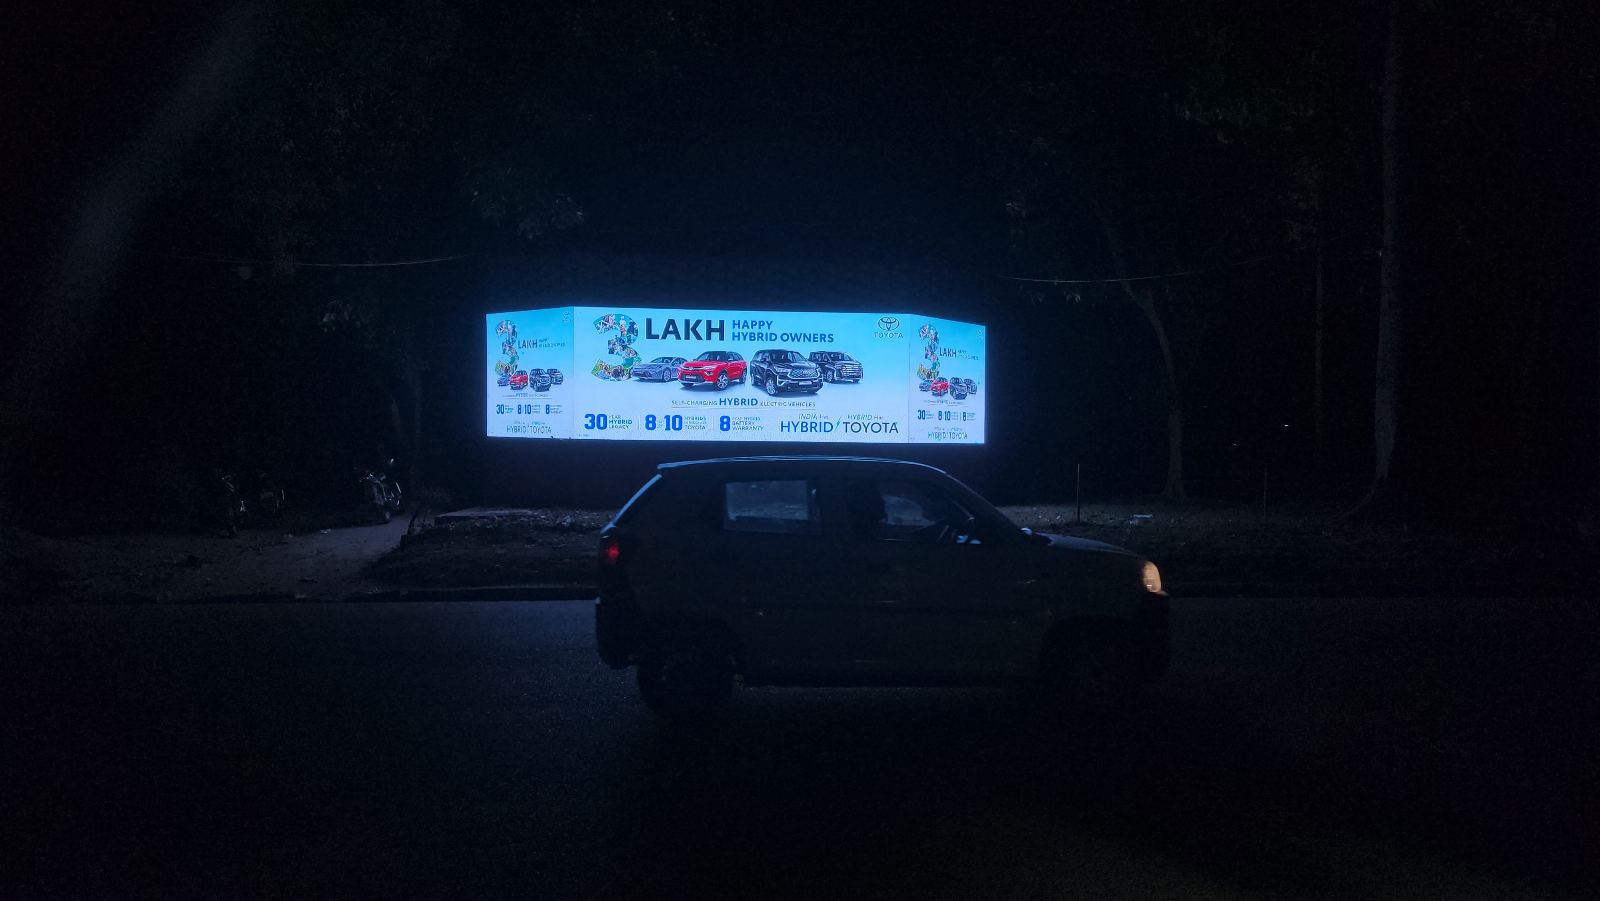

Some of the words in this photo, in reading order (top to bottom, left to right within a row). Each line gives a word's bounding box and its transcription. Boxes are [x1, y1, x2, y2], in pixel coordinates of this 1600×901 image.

[732, 319, 773, 330] HAPPY
[732, 331, 778, 342] HYBRID
[780, 332, 834, 343] OWNERS
[874, 331, 904, 339] TOYOTA
[517, 339, 538, 349] LAKH
[591, 313, 642, 381] 3
[645, 318, 725, 341] LAKH
[939, 347, 957, 358] LAKH
[719, 398, 758, 406] HYBRID
[495, 404, 505, 415] 30
[917, 409, 926, 420] 30
[584, 413, 608, 430] 30
[645, 414, 657, 431] 8
[664, 414, 683, 431] 10
[719, 415, 731, 431] 8
[780, 420, 834, 433] HYBRID
[842, 421, 899, 434] TOYOTA
[529, 425, 552, 434] TOYOTA
